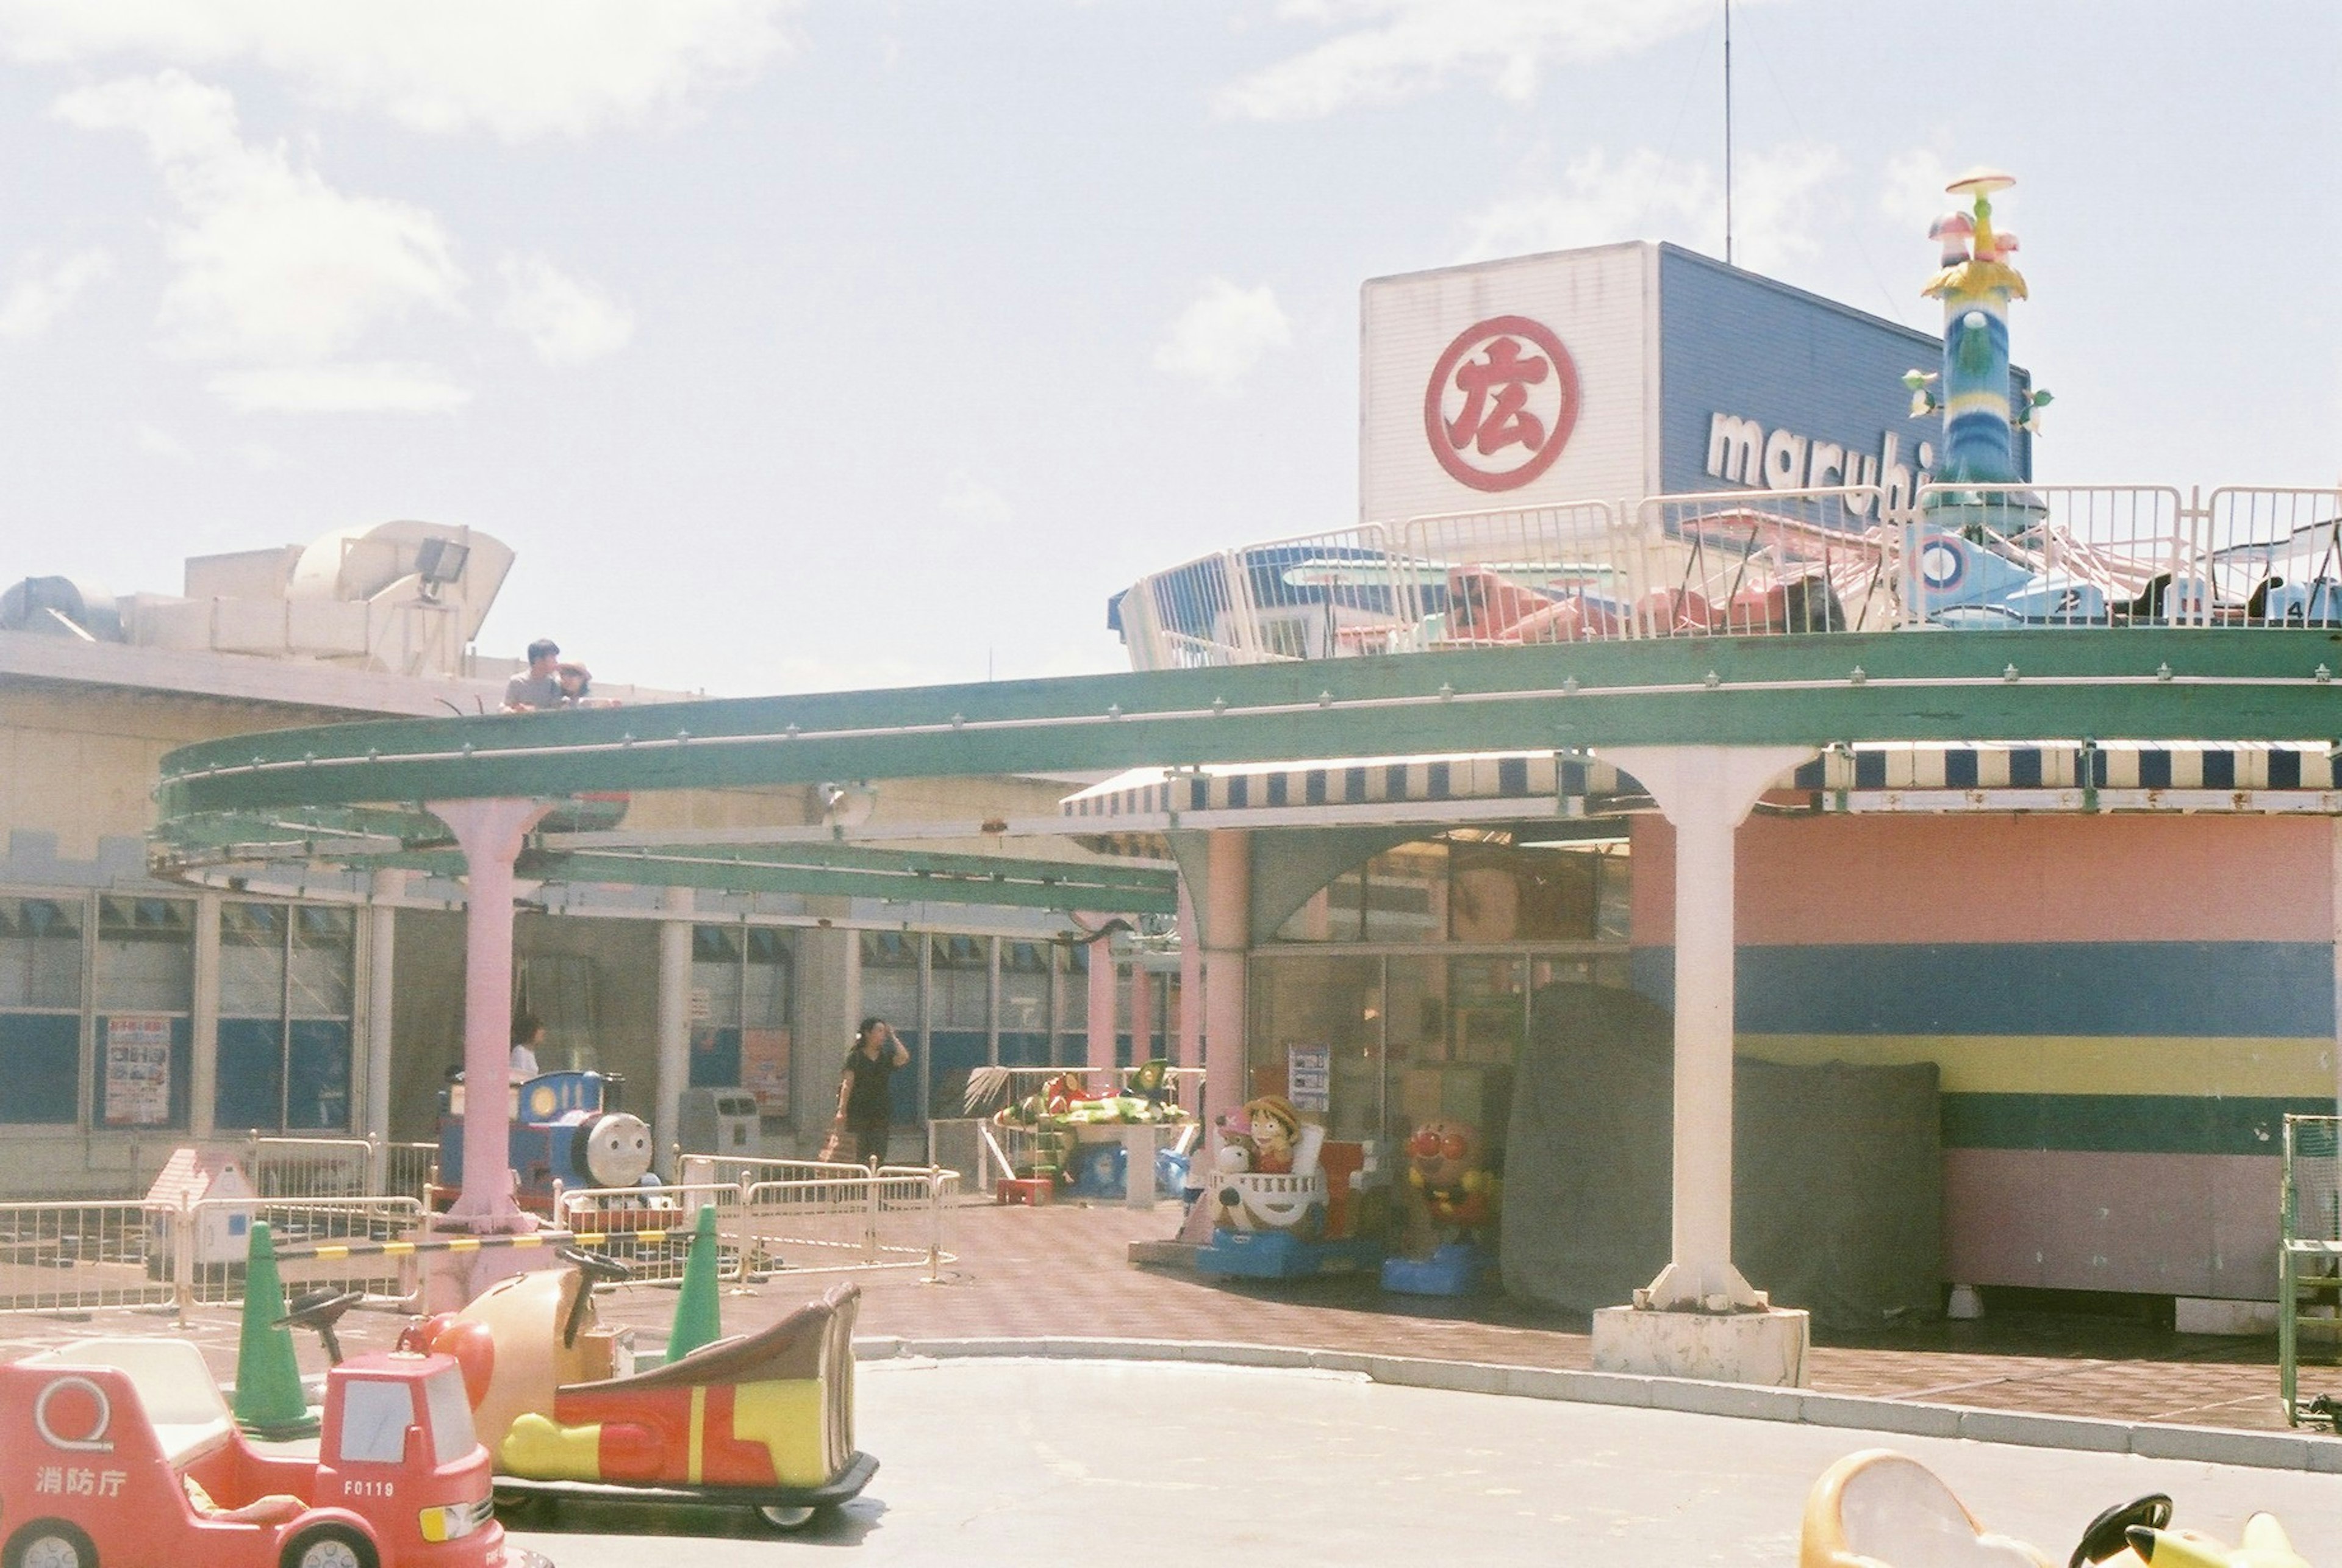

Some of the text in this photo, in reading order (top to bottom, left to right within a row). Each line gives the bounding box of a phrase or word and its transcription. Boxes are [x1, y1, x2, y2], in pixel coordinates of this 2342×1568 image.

[1443, 336, 1550, 456] 広
[35, 1466, 127, 1497] 消防庁
[344, 1481, 393, 1496] F0119
